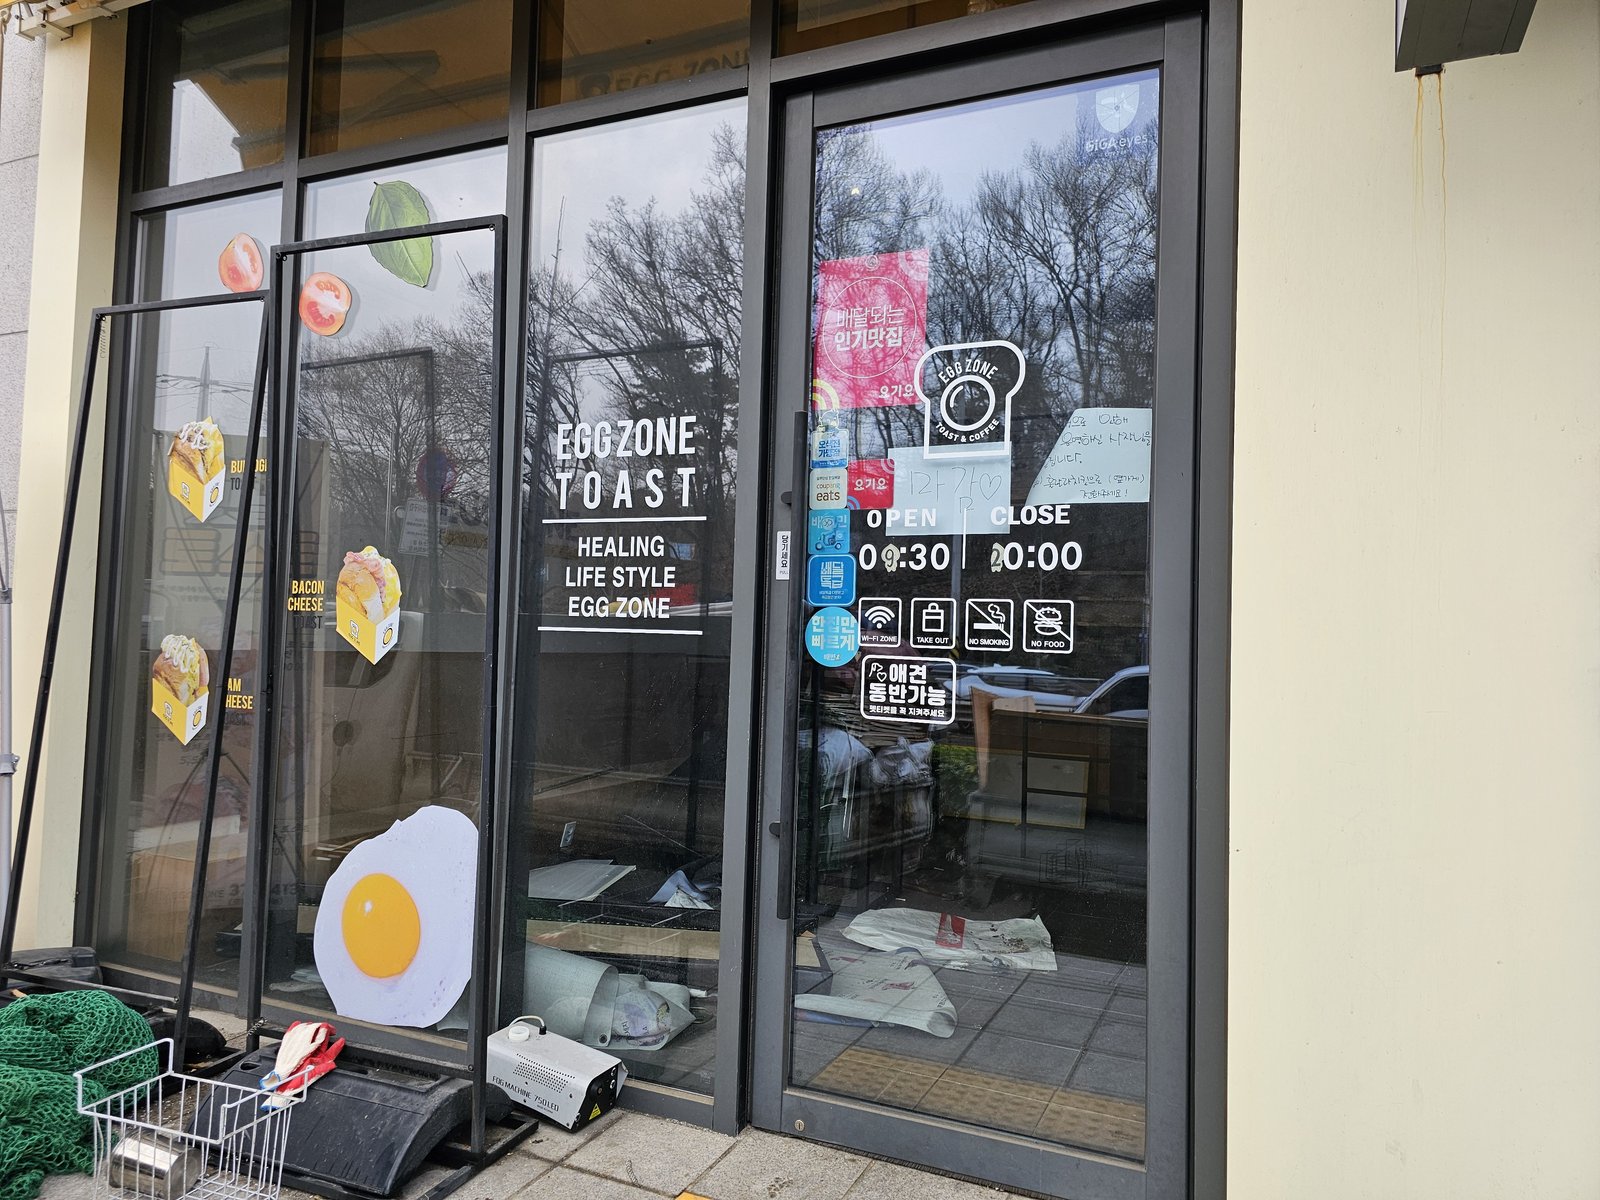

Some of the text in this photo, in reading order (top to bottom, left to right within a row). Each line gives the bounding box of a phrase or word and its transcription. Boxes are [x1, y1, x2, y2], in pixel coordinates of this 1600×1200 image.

[834, 326, 904, 352] 인기맛집
[938, 359, 999, 384] EGG ZONE
[878, 384, 915, 399] 요기요
[556, 415, 697, 460] EGG ZONE
[935, 418, 1000, 443] TOAST & COFFEE
[555, 467, 696, 510] TOAST
[854, 477, 889, 491] 요기요
[816, 490, 841, 502] eats
[867, 504, 1071, 528] OPEN CLOSE
[577, 535, 665, 558] HEALING
[565, 566, 676, 588] LIFE STYLE
[291, 580, 325, 595] BACON
[287, 597, 324, 611] CHEESE
[568, 596, 671, 619] EGG ZONE
[811, 633, 855, 651] 빠르게
[879, 635, 898, 643] ZONE
[916, 636, 934, 644] TAKE
[979, 638, 1009, 646] SMOKING
[1043, 640, 1065, 648] FOOD
[889, 663, 927, 685] 애견
[227, 677, 241, 692] AM
[225, 695, 254, 710] HEESE
[869, 682, 947, 706] 동반가능
[899, 706, 907, 715] 꼭
[908, 707, 945, 718] 지켜주세요
[492, 1075, 505, 1087] FOG
[504, 1081, 531, 1099] MACHINE
